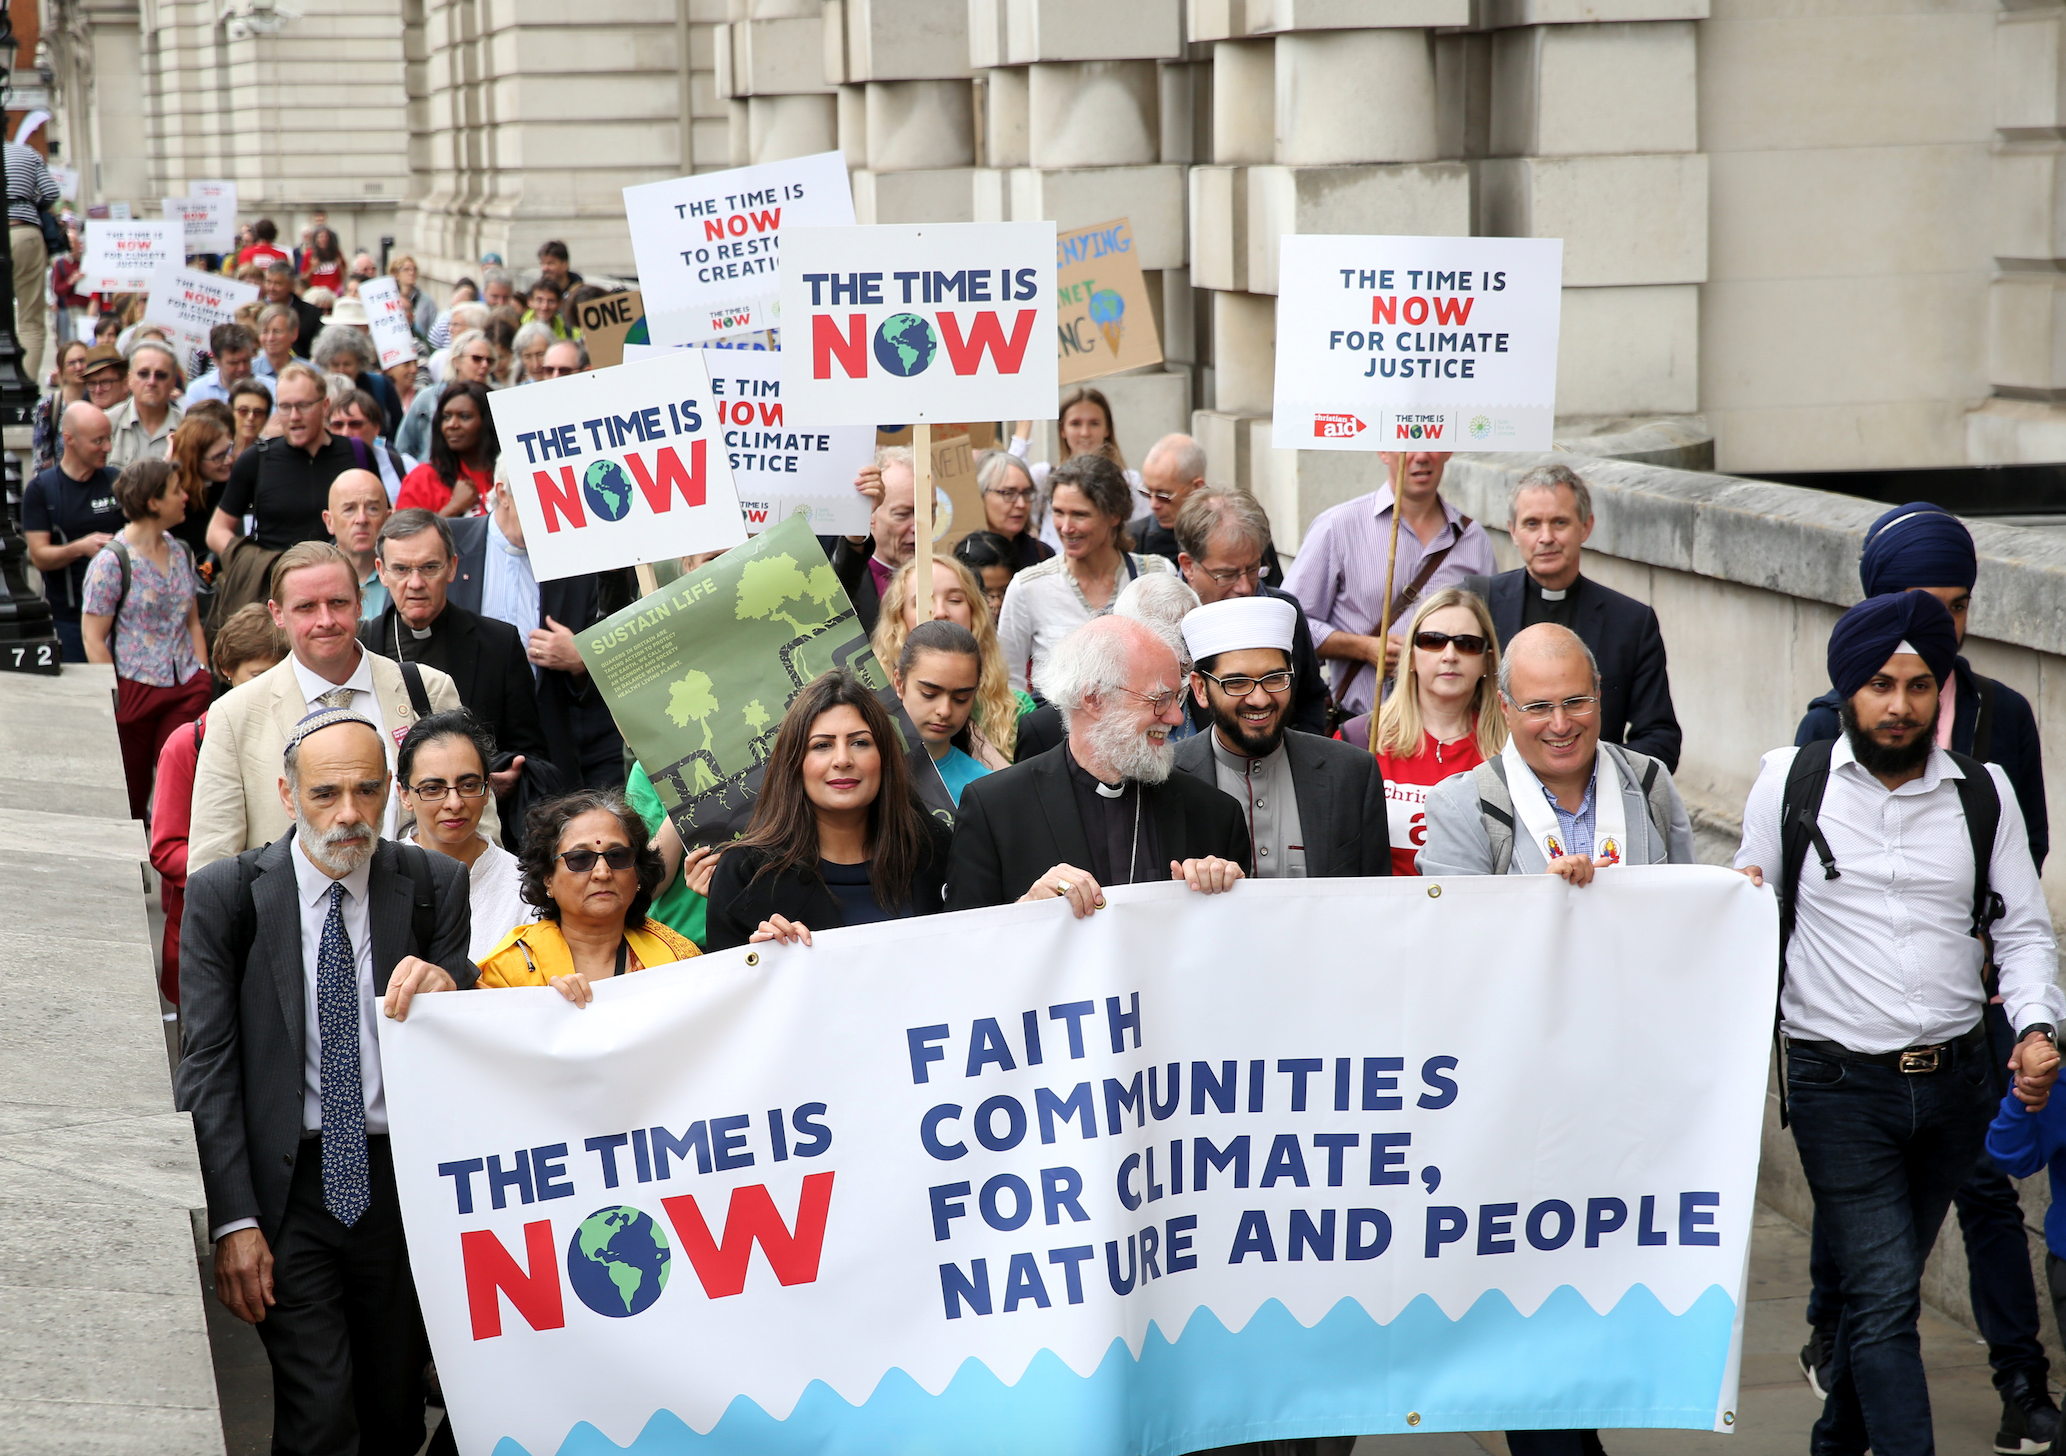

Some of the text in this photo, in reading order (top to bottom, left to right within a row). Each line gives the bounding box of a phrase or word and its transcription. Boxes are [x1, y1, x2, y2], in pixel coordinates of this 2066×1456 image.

[674, 183, 804, 220] THE TIME IS
[105, 231, 163, 240] THE TIME IS
[703, 207, 782, 242] NOW
[104, 251, 166, 260] FOR CLIMATE
[117, 241, 152, 251] NOW
[680, 235, 778, 267] TO REST
[1057, 225, 1132, 269] ENYING
[116, 260, 154, 269] JUSTICE
[698, 257, 779, 284] CREATI
[176, 277, 235, 301] THE TIME IS
[803, 268, 1037, 305] THE TIME IS
[1340, 269, 1506, 291] THE TIME IS
[184, 290, 221, 308] NOW
[1057, 279, 1095, 309] NET
[168, 298, 233, 322] FOR CLIMATE
[178, 311, 218, 326] JUSTICE
[583, 298, 633, 331] ONE
[709, 311, 723, 319] THE
[725, 308, 742, 316] TIME
[712, 313, 750, 330] NOW
[1372, 296, 1474, 326] NOW
[811, 309, 1038, 380] NOW
[1330, 331, 1509, 353] FOR CLIMATE
[1364, 358, 1475, 379] JUSTICE
[736, 379, 780, 398] TIM
[1314, 414, 1348, 423] christian
[1323, 417, 1358, 437] aid
[1395, 414, 1445, 422] THE TIME IS
[1396, 424, 1444, 439] NOW
[515, 399, 703, 465] THE TIME IS
[725, 431, 830, 451] CLIMATE
[729, 453, 799, 473] STICE
[532, 438, 707, 534] NOW
[740, 501, 759, 509] TIME
[591, 577, 718, 655] SUSTAIN LIFE
[601, 652, 626, 668] QUAKERS
[633, 635, 656, 650] BRITAIN
[656, 629, 668, 638] ARE
[604, 661, 625, 674] TAKING
[625, 650, 645, 663] ACTION
[652, 632, 677, 648] PROTECT
[607, 671, 619, 680] THE
[648, 649, 662, 658] CALL
[661, 641, 673, 650] FOR
[619, 666, 644, 681] ECONOMY
[644, 659, 656, 668] AND
[656, 646, 679, 661] SOCIETY
[622, 673, 646, 689] BALANCE
[646, 664, 661, 674] WITH
[617, 660, 683, 699] HEALTHY LIVING PLANET.
[1384, 785, 1427, 804] chris
[906, 990, 1142, 1085] FAITH
[920, 1055, 1460, 1162] COMMUNITIES
[437, 1102, 834, 1215] THE TIME IS
[928, 1131, 1442, 1242] FOR CLIMATE,
[460, 1170, 836, 1342] NOW
[938, 1191, 1721, 1321] NATURE AND PEOPLE
